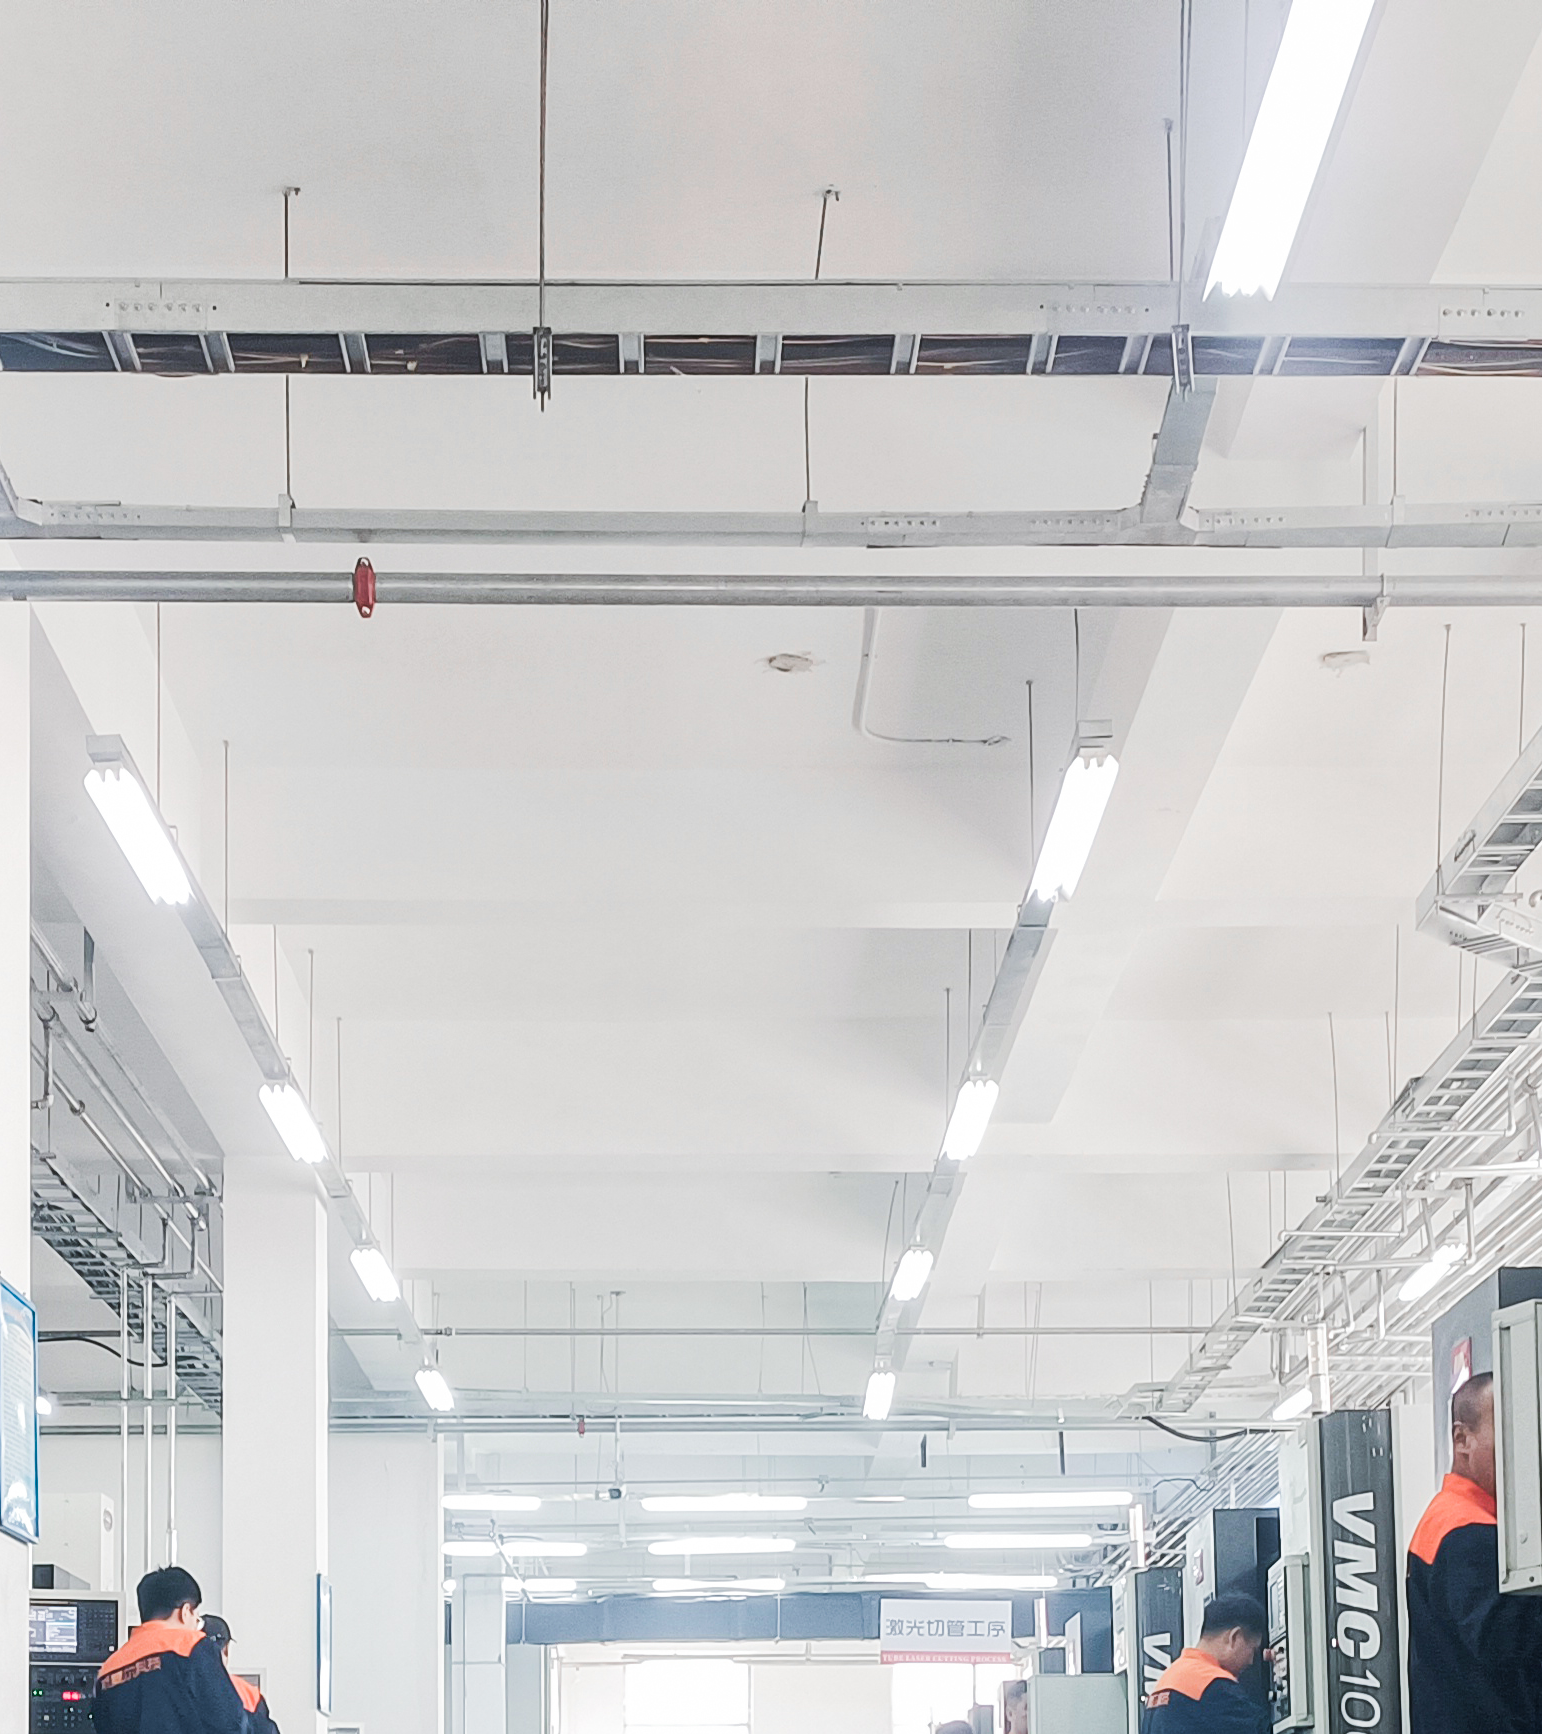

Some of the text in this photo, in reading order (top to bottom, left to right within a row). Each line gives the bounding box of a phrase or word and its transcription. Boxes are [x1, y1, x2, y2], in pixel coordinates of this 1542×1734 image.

[885, 1618, 1006, 1638] 激光切管工序
[882, 1653, 1007, 1663] TUBE LASER CUTTING PROCESS
